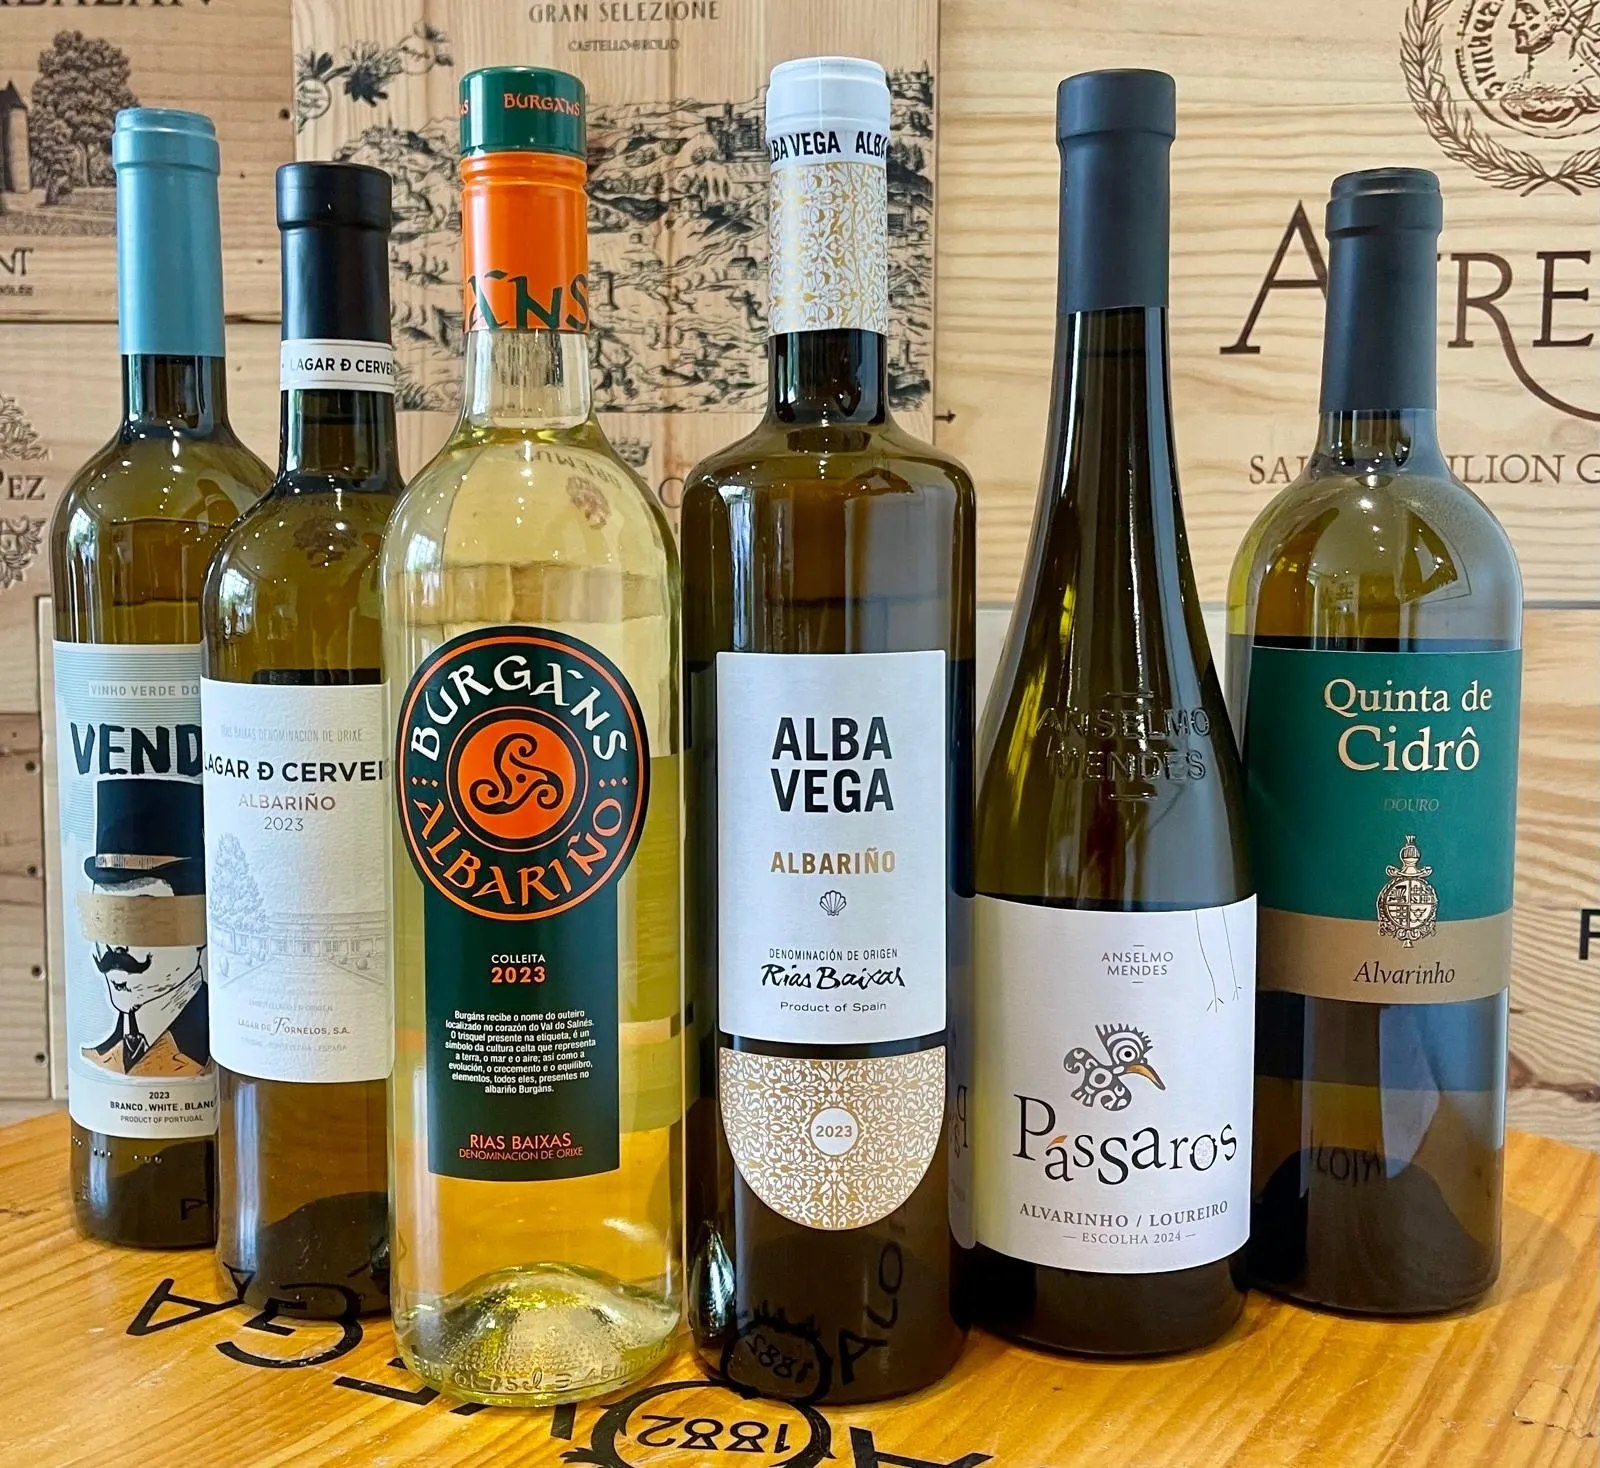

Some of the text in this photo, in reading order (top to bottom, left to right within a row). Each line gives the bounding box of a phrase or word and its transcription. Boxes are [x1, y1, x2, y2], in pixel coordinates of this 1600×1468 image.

[528, 0, 721, 24] GRAN SELEZIONE
[789, 131, 841, 157] VEGA
[290, 357, 335, 372] LAGAR
[356, 359, 393, 376] CERVE
[91, 685, 127, 696] VINHO
[131, 685, 176, 696] VERDE
[1324, 678, 1493, 718] Quinta de
[1036, 707, 1210, 740] ANSELMO
[771, 716, 893, 761] ALBA
[1338, 724, 1481, 772] Cidrô
[1052, 749, 1207, 782] MENDES
[770, 768, 895, 814] VEGA
[239, 793, 336, 811] ALBARIÑO
[1383, 798, 1440, 813] DOURO
[264, 816, 304, 832] 2023
[413, 797, 624, 907] ALBARIÑO
[770, 847, 896, 875] ALBARIÑO
[491, 954, 546, 964] COLLEITA
[769, 948, 898, 961] DENOMINACIÓN DE ORIGEN
[1101, 951, 1174, 963] ANSELMO
[491, 966, 546, 984] 2023
[1107, 964, 1168, 976] MENDES
[1353, 961, 1456, 985] Alvarinho
[816, 966, 906, 990] Baixas
[780, 1001, 887, 1013] Product of Spain
[454, 1009, 585, 1022] Burgáns recibe o nome do outeiro
[445, 1019, 482, 1031] localizado
[483, 1024, 494, 1032] no
[495, 1023, 527, 1032] corazón
[528, 1022, 539, 1031] do
[540, 1022, 553, 1031] Val
[555, 1021, 565, 1030] do
[450, 1029, 590, 1043] O trisquel presente na etiqueta, é un
[474, 1042, 485, 1052] da
[486, 1043, 514, 1053] cultura
[515, 1043, 536, 1052] celta
[537, 1044, 553, 1053] que
[554, 1038, 596, 1051] representa
[461, 1052, 482, 1063] terra,
[490, 1055, 507, 1063] mar
[515, 1055, 520, 1063] o
[556, 1053, 578, 1061] como
[580, 1051, 585, 1059] a
[448, 1062, 486, 1074] evolución,
[493, 1064, 541, 1074] crecemento
[550, 1064, 556, 1072] o
[451, 1070, 590, 1084] elementos, todos eles, presentes no
[149, 1091, 170, 1100] 2023
[485, 1084, 555, 1095] albariño Burgáns.
[110, 1101, 143, 1111] BRANCO
[149, 1102, 179, 1112] WHITE
[120, 1115, 204, 1124] PRODUCT OF PORTUGAL
[815, 1125, 853, 1138] 2023
[470, 1132, 573, 1150] RIAS BAIXAS
[1012, 1093, 1238, 1186] Pássaros
[541, 1149, 554, 1160] DE
[557, 1147, 584, 1159] ORIXE
[1019, 1203, 1129, 1228] ALVARINHO
[1150, 1200, 1229, 1227] LOUREIRO
[1082, 1230, 1182, 1245] ESCOLHA 2024
[636, 1414, 790, 1455] 1882
